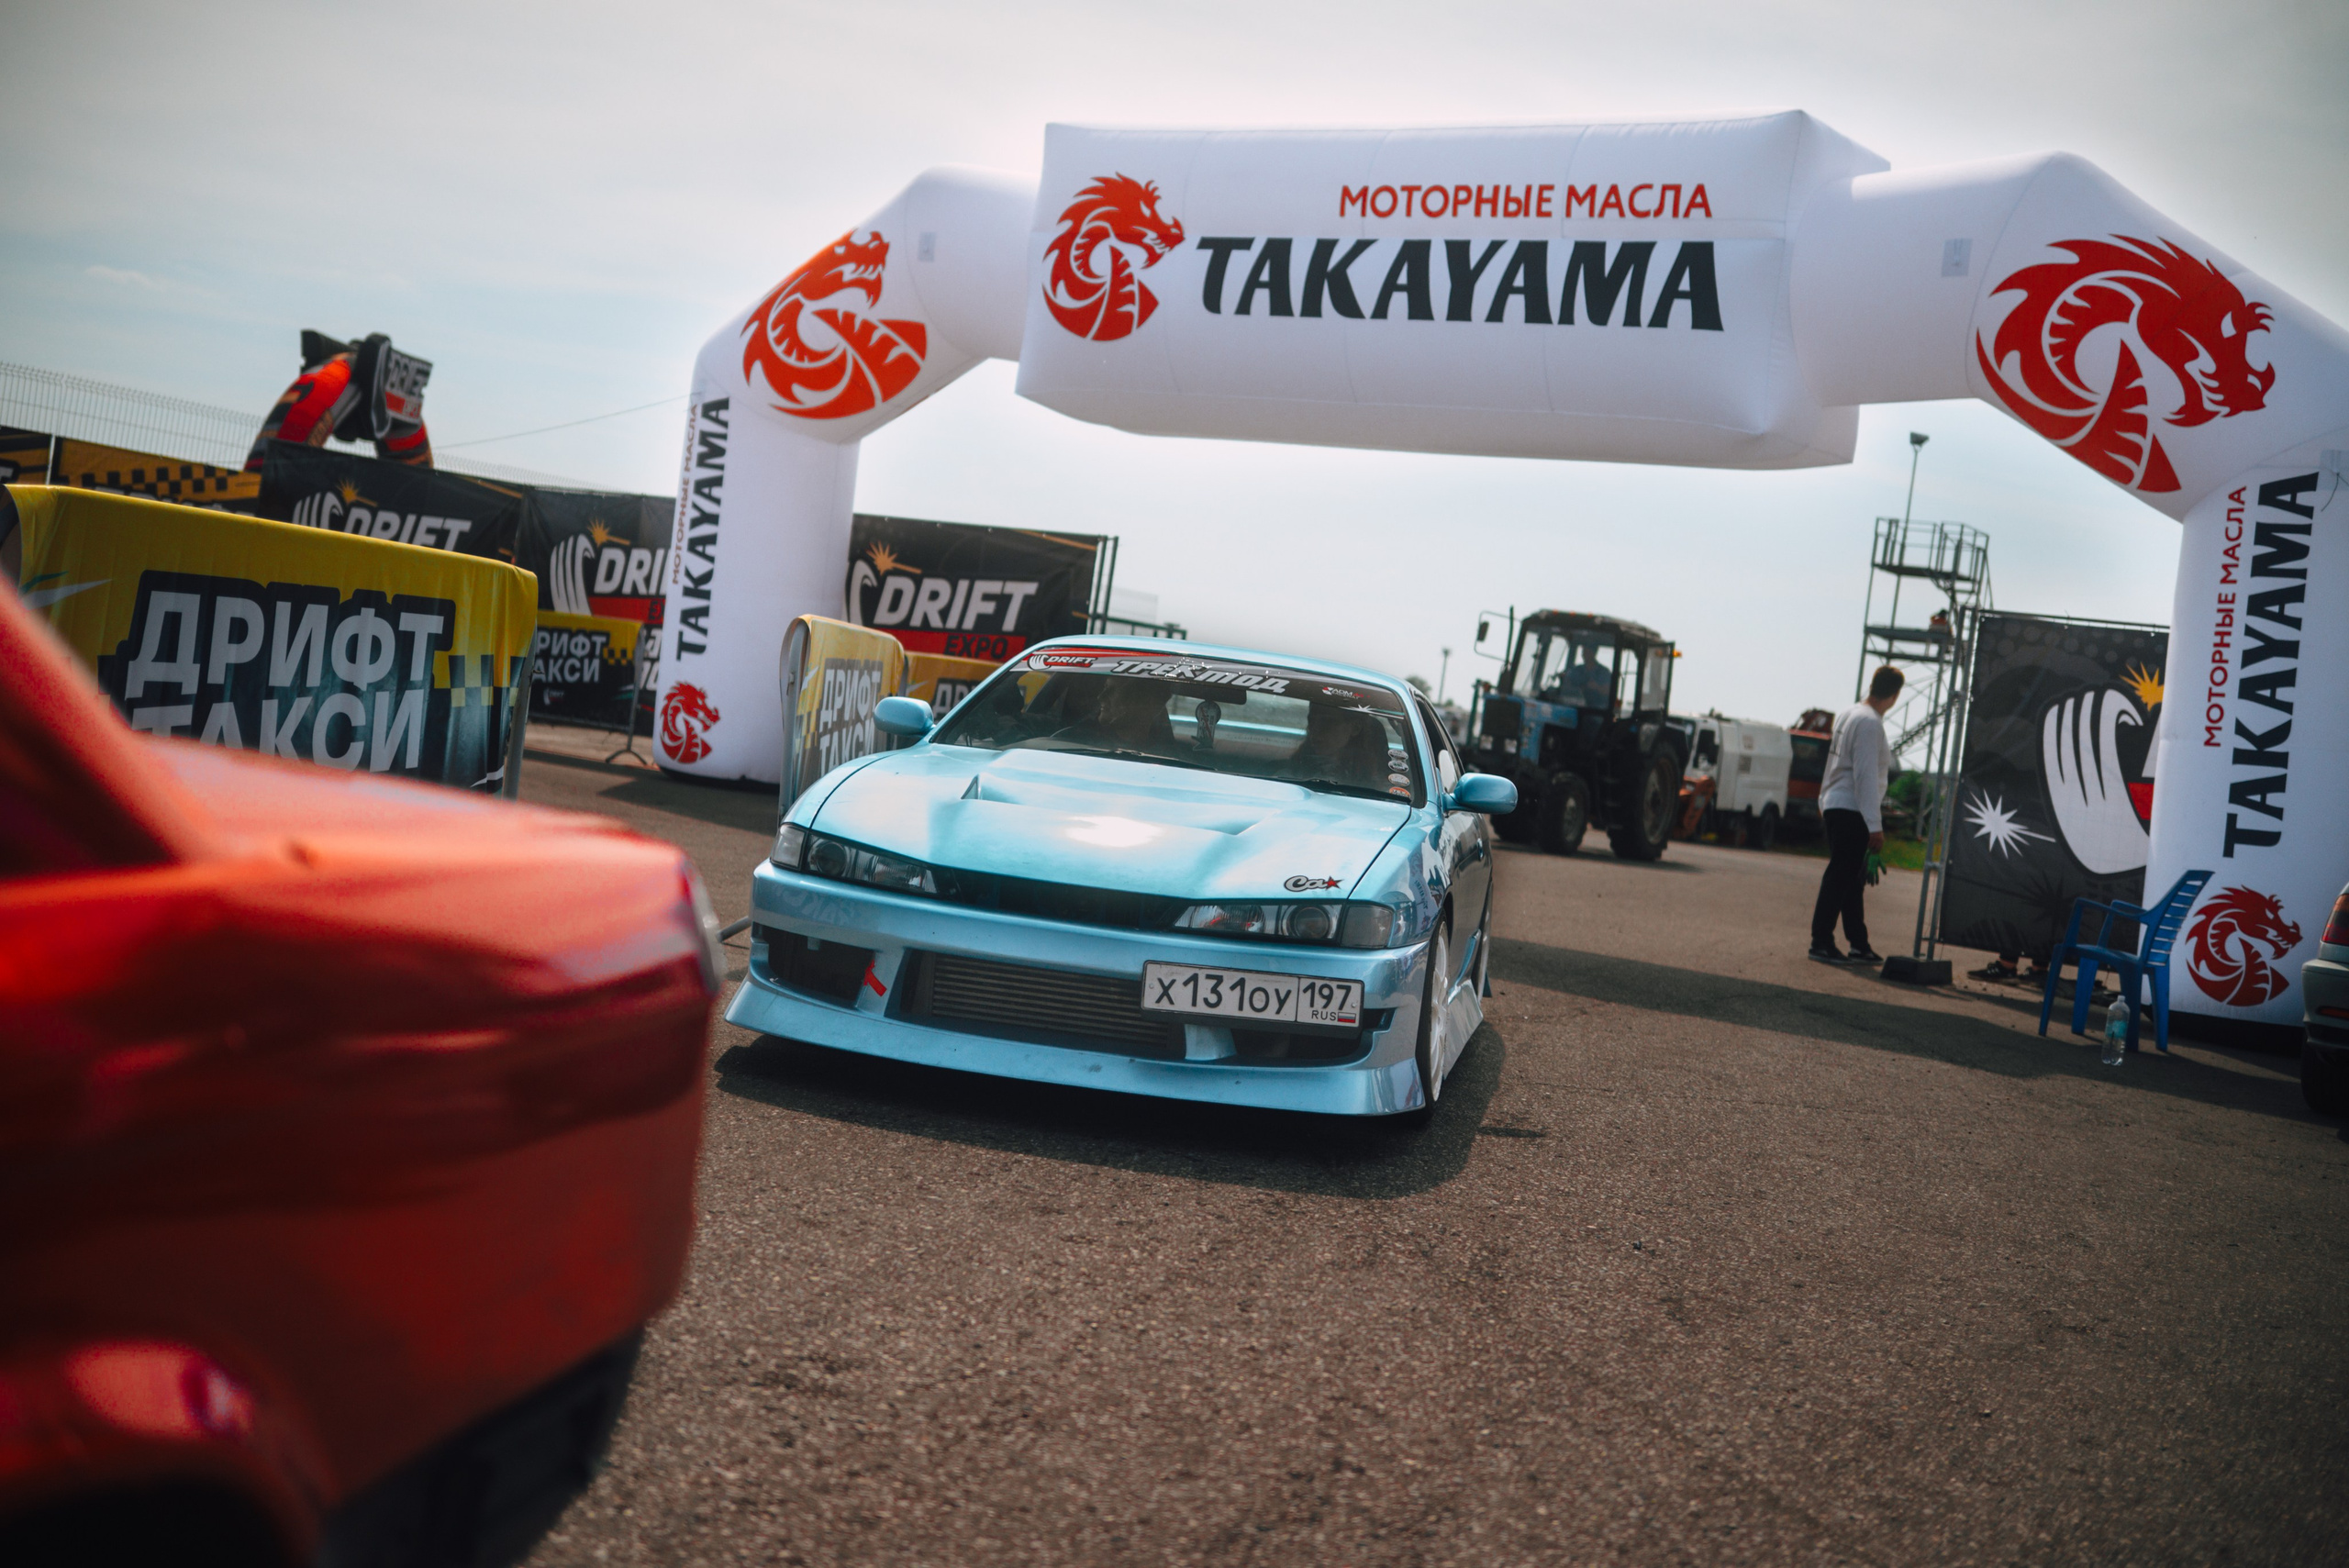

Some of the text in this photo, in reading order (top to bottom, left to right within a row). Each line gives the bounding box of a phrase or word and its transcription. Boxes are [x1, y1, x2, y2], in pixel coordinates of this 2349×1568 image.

[1339, 183, 1713, 219] МОТОРНЫЕ МАСЛА
[1196, 237, 1725, 331] TAKAYAMA
[672, 404, 697, 585] МОТОРНЫЕ МАСЛА
[675, 396, 730, 662] TAKAYAMA
[594, 547, 671, 595] DRI
[873, 574, 1040, 632] DRIFT
[2203, 485, 2247, 748] МОТОРНЫЕ МАСЛА
[124, 590, 445, 701] ДРИФТ
[531, 657, 600, 683] АКСИ
[536, 630, 607, 658] РИФТ
[943, 634, 1009, 660] EXPO
[1046, 655, 1097, 665] DRIFT
[2222, 471, 2320, 859] TAKAYAMA
[818, 667, 881, 734] ДРИФТ
[1303, 981, 1353, 1011] 197
[1311, 1009, 1337, 1021] RUS
